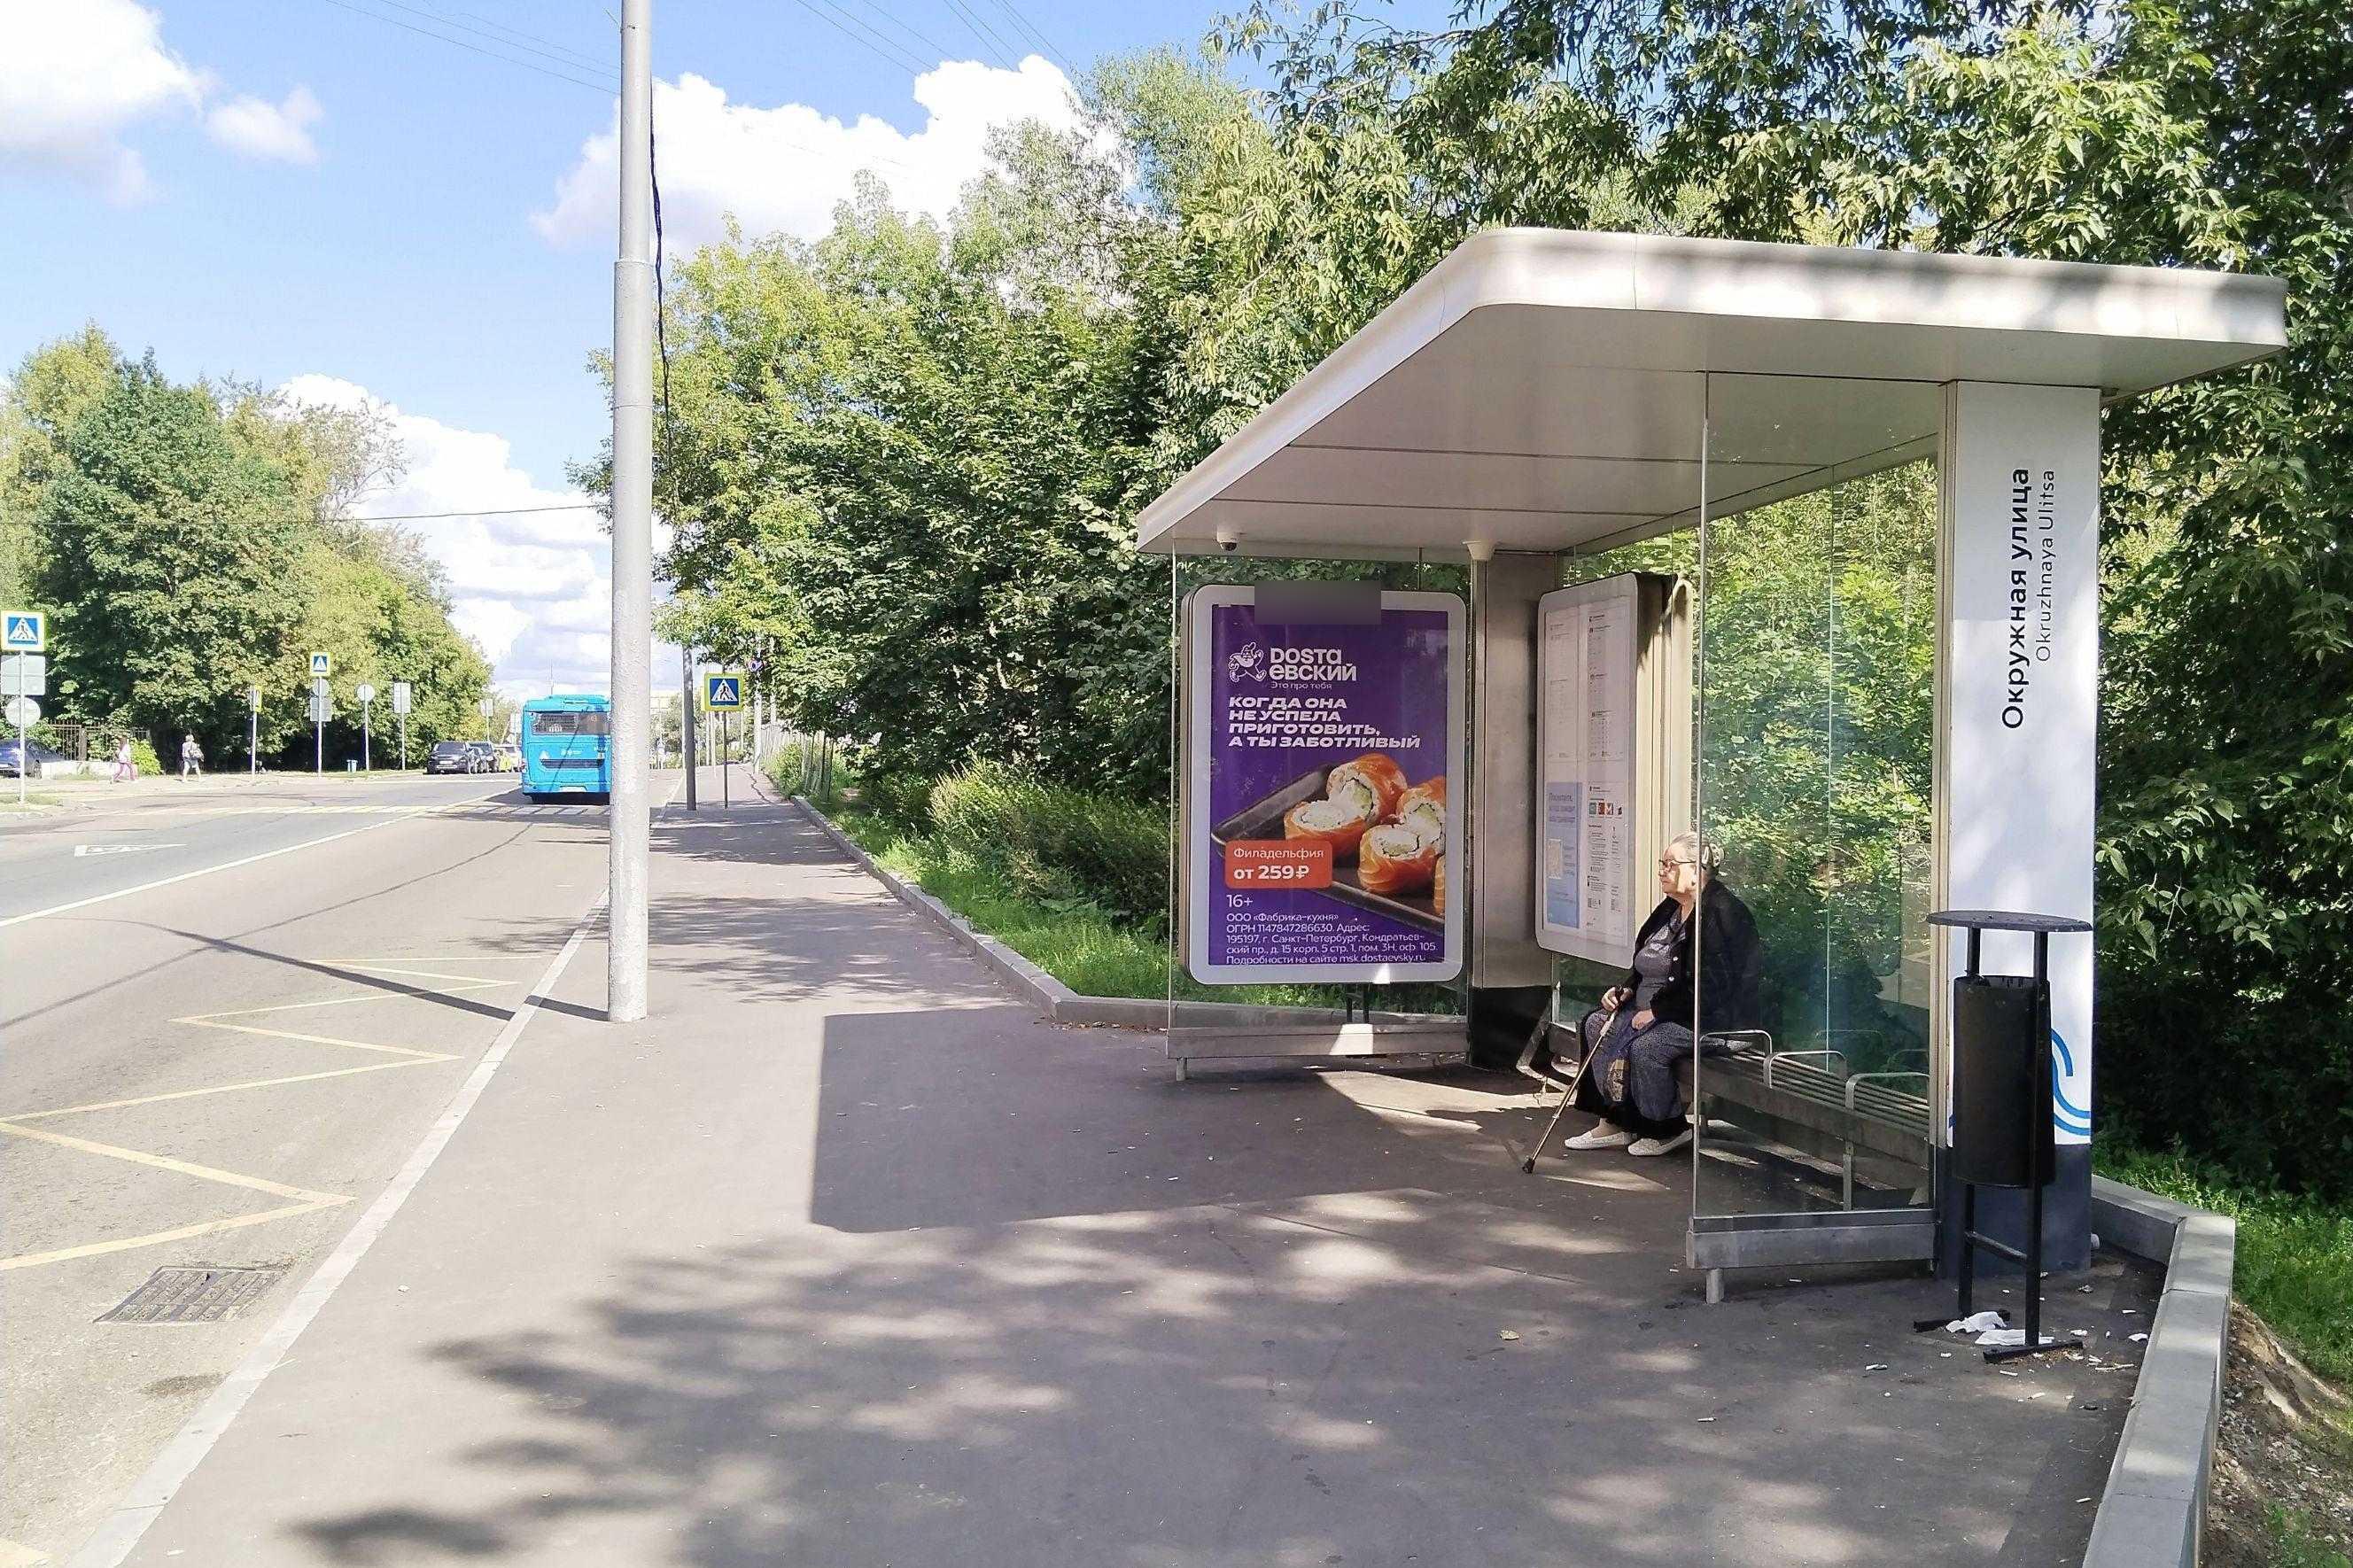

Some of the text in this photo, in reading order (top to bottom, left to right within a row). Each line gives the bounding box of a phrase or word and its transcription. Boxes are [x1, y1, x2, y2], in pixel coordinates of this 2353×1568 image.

[2035, 470, 2056, 662] Okruzhnaya Ulitsa
[2001, 469, 2032, 729] Окружная улица
[1290, 682, 1309, 691] про
[1310, 681, 1332, 690] тебя
[1228, 696, 1347, 710] КОГДА ОНА
[1228, 710, 1342, 722] НЕ УСПЕЛА
[1228, 723, 1381, 736] ПРИГОТОВИТЬ,
[1228, 734, 1421, 749] А ТЫ ЗАБОТЛИВЫЙ
[1233, 847, 1324, 860] Филадельфия
[1233, 868, 1254, 880] от
[1226, 894, 1254, 908] 16+
[1226, 912, 1252, 922] ООО
[1226, 924, 1255, 933] ОГРН
[1226, 945, 1250, 954] ский
[1281, 944, 1292, 953] 15
[1321, 944, 1329, 953] 5
[1226, 955, 1293, 965] Подробности
[1295, 956, 1308, 965] на
[1309, 955, 1338, 965] сайте
